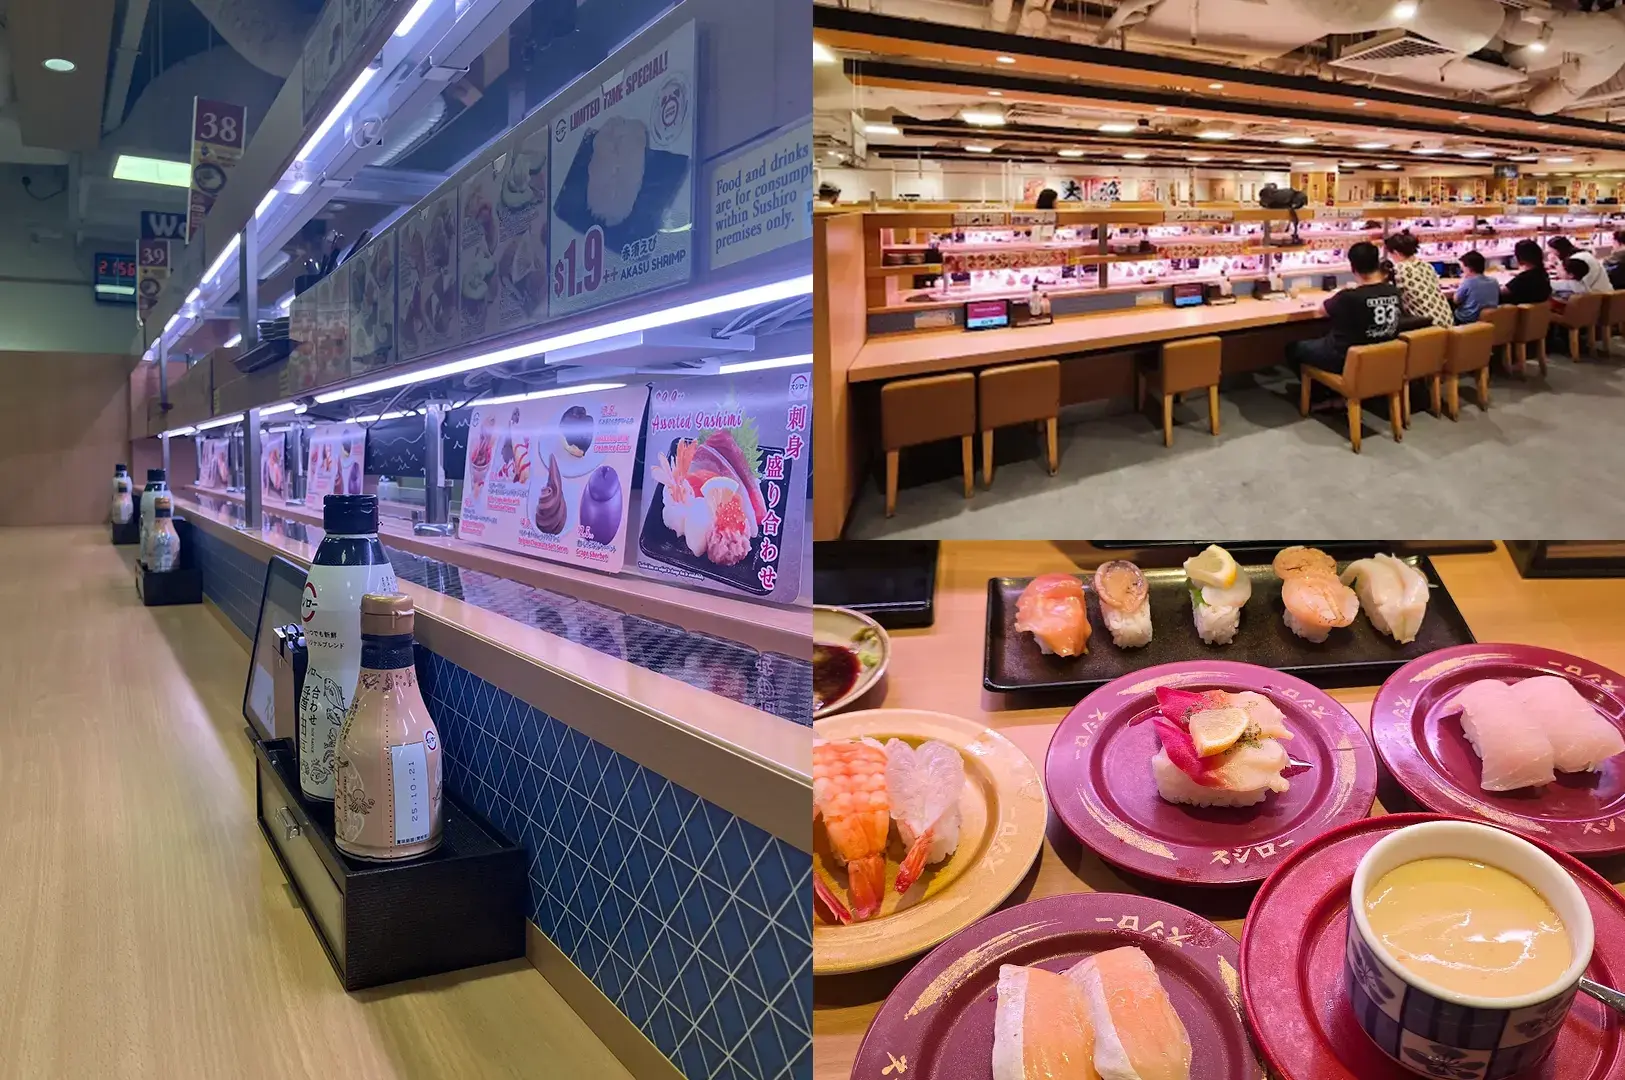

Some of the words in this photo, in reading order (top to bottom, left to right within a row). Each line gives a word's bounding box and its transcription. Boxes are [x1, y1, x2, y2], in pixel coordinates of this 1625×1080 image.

[570, 97, 600, 131] LIMITED
[603, 80, 624, 110] TIME
[625, 50, 669, 96] SPECIAL!
[200, 112, 237, 142] 38
[715, 170, 742, 196] Food
[745, 158, 766, 183] and
[770, 142, 809, 172] drinks
[715, 198, 732, 214] are
[735, 188, 751, 206] for
[715, 207, 749, 231] within
[752, 188, 798, 218] Sushiro
[715, 223, 762, 254] premises
[766, 208, 795, 230] only.
[141, 247, 165, 265] 39
[620, 260, 650, 281] AKASU
[651, 249, 687, 271] SHRIMP
[1374, 305, 1396, 325] 83
[652, 412, 692, 434] Assorted
[695, 409, 743, 428] Sashimi
[786, 405, 806, 459] 刺身
[759, 455, 783, 589] 盛り合わせ
[1548, 660, 1623, 693] スシロー
[309, 685, 321, 726] 合わせ
[1269, 684, 1333, 719] スシロー
[1393, 695, 1411, 732] スシロ
[1074, 707, 1109, 760] スシロー
[1209, 839, 1295, 865] スシロー
[1095, 915, 1194, 948] スシロー
